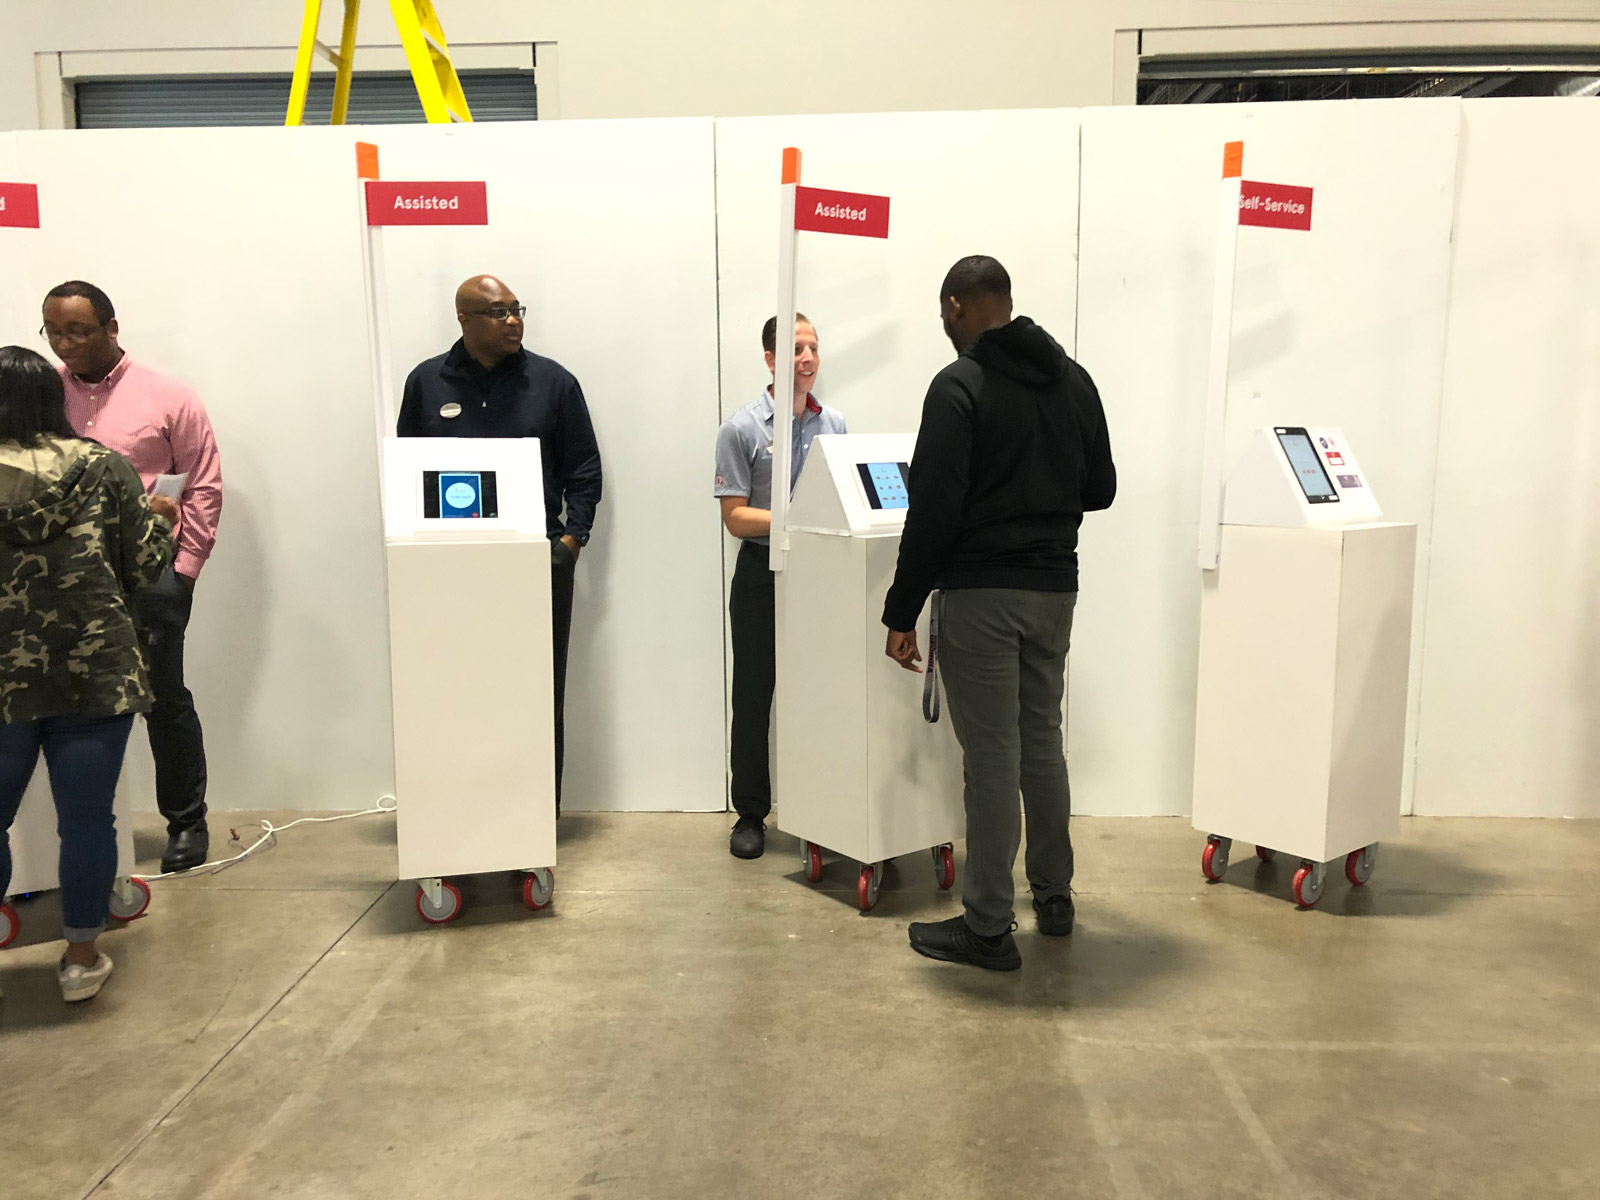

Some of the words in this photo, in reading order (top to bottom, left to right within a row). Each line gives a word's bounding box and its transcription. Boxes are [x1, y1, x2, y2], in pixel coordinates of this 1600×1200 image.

[394, 195, 458, 209] Assisted
[814, 202, 866, 221] Assisted
[1239, 194, 1304, 214] Self-Service
